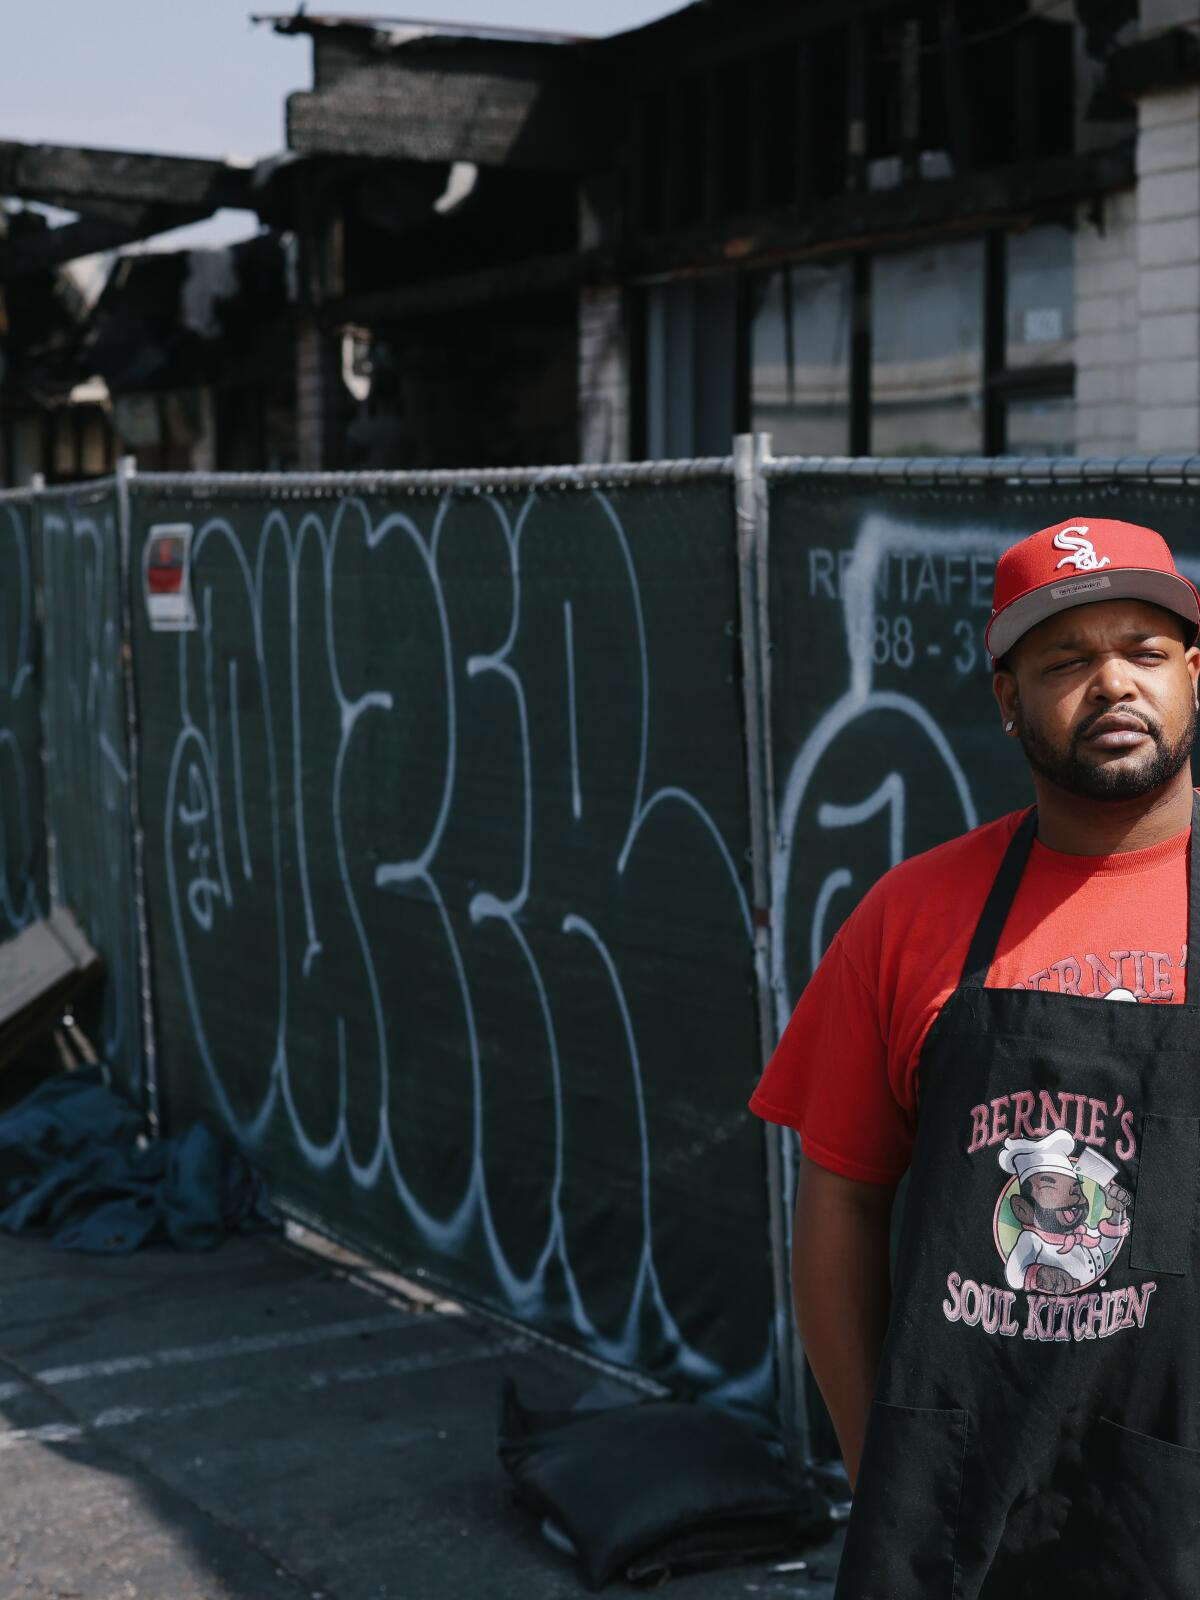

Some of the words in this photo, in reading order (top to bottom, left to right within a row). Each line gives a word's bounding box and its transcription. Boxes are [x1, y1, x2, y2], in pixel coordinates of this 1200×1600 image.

[967, 1090, 1137, 1160] BERNIE'S
[942, 1271, 1018, 1336] SOUL
[1022, 1281, 1157, 1342] KITCHEN
